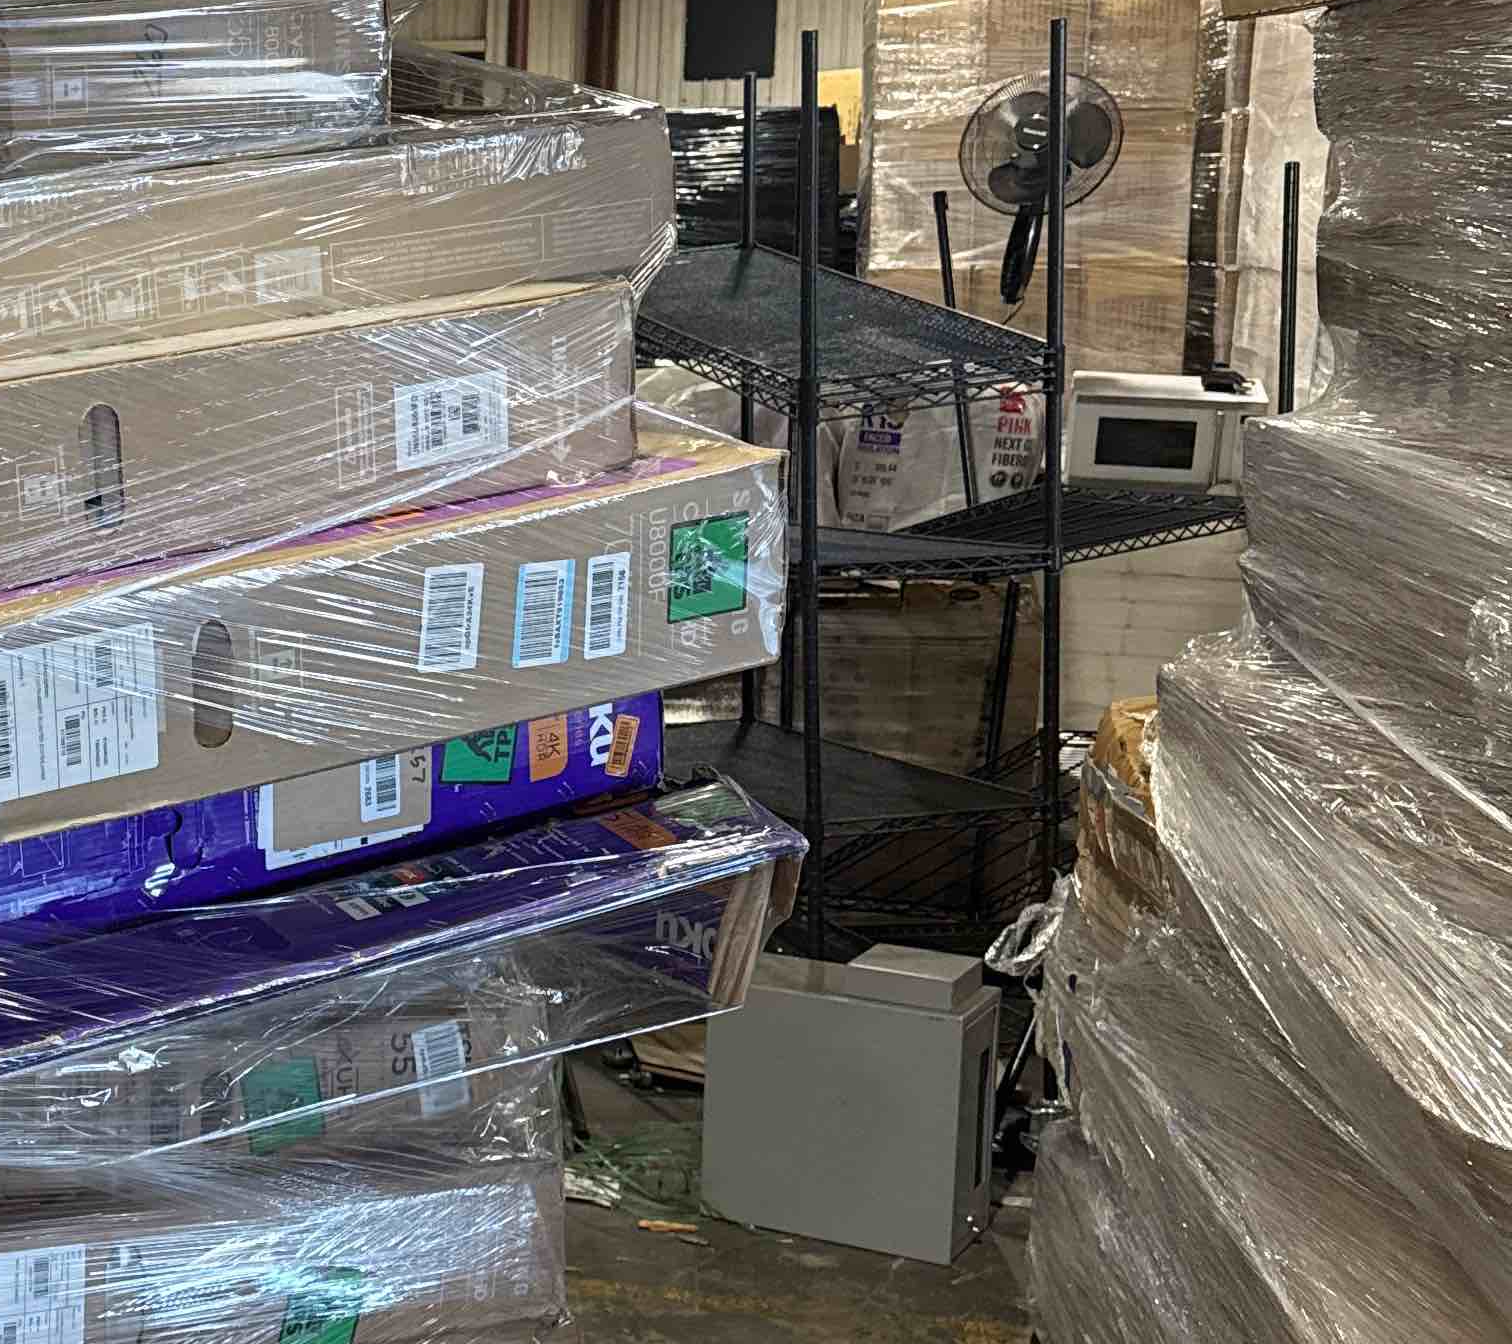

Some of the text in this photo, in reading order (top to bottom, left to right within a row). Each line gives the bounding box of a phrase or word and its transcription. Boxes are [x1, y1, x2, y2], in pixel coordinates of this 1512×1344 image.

[997, 416, 1032, 433] PINK
[994, 438, 1022, 450] NEXT
[647, 506, 678, 601] U8000F
[545, 732, 562, 761] 4K
